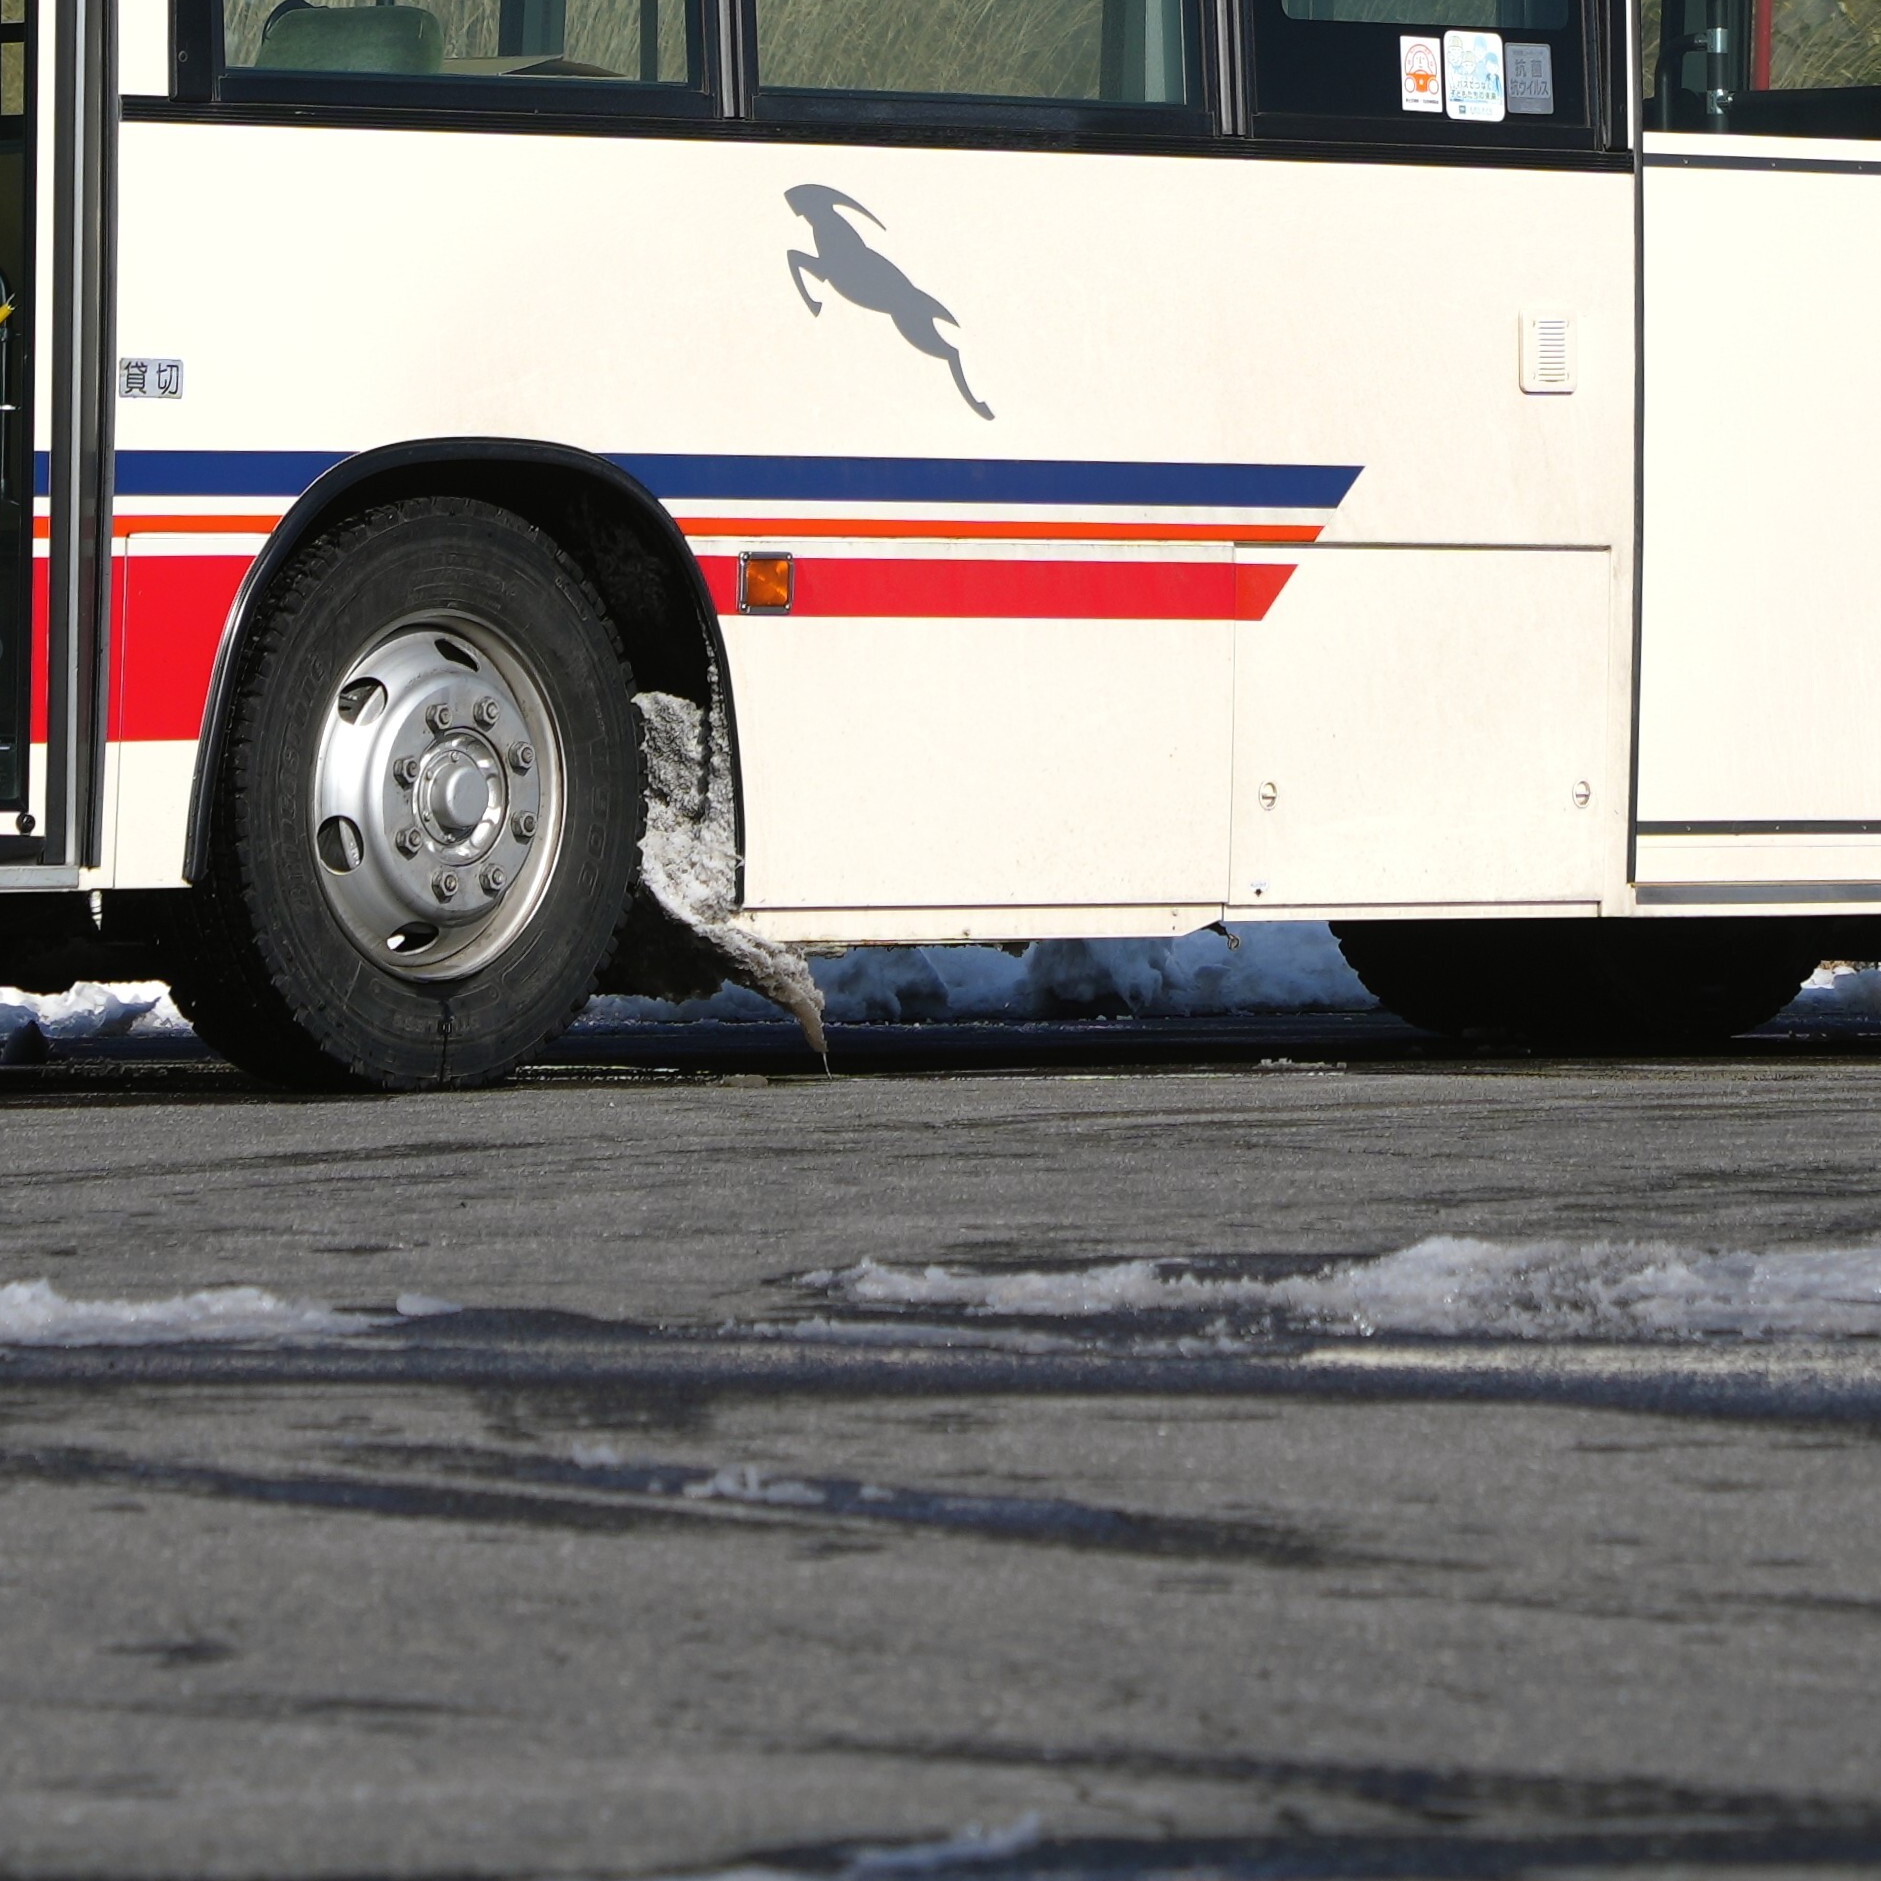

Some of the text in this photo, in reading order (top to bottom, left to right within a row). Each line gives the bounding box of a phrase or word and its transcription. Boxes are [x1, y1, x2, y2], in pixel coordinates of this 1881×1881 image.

[1515, 58, 1543, 78] 抗菌
[1510, 78, 1549, 96] 抗ウイルス
[124, 361, 179, 395] 貸切
